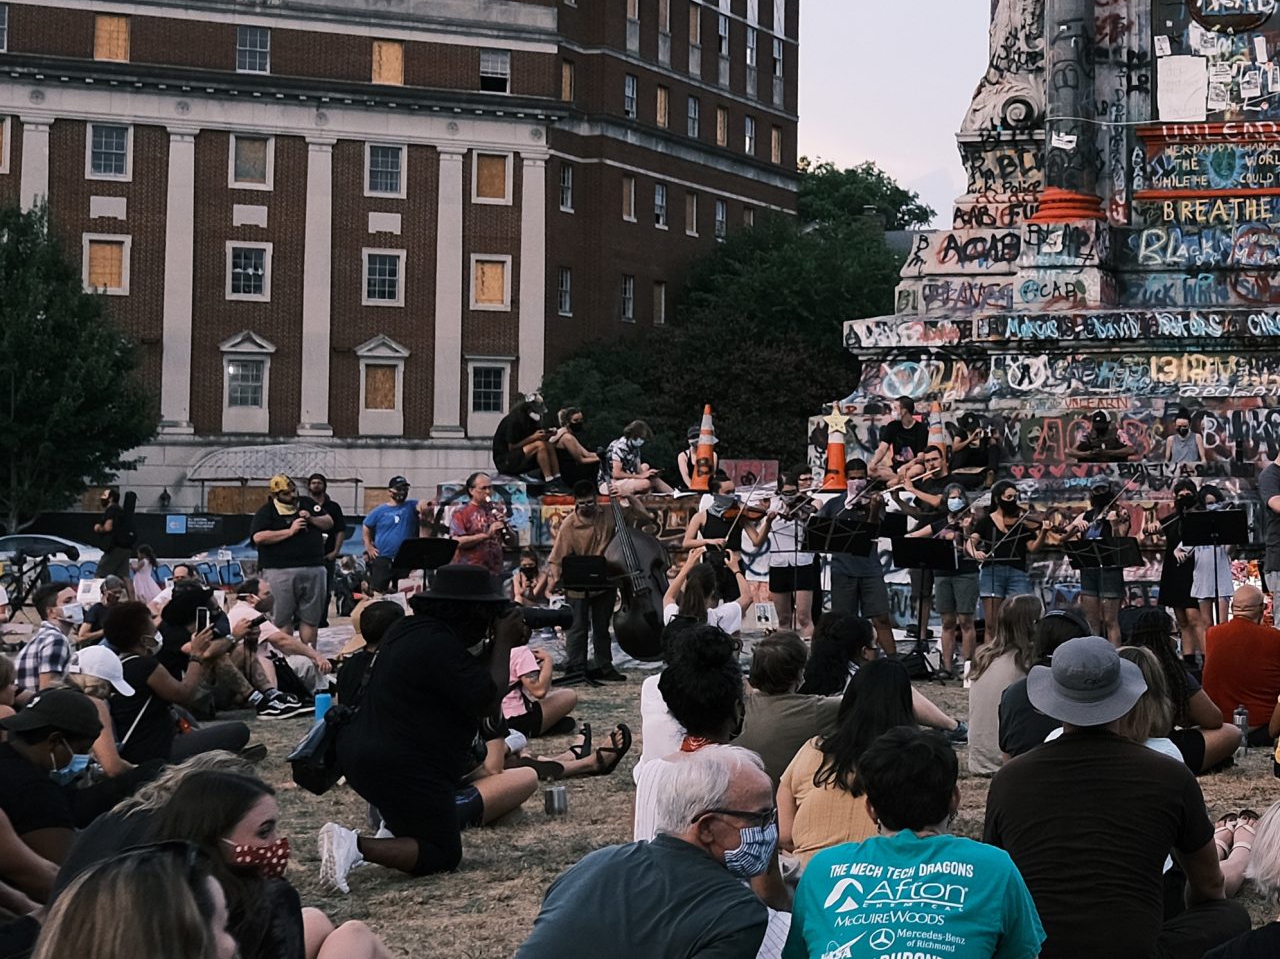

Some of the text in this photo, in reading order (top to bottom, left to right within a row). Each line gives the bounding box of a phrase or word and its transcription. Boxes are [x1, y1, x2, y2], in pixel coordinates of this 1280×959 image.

[1174, 158, 1200, 171] THE
[1194, 174, 1209, 187] HE
[1239, 173, 1274, 184] COULD
[1163, 197, 1274, 223] BREATHE
[1064, 397, 1129, 409] UNLEARN
[830, 861, 974, 879] THE MECH TECH DRAGONS
[866, 879, 966, 903] Afton
[897, 928, 967, 945] Mercedes-Benz
[906, 939, 956, 953] of Richmond
